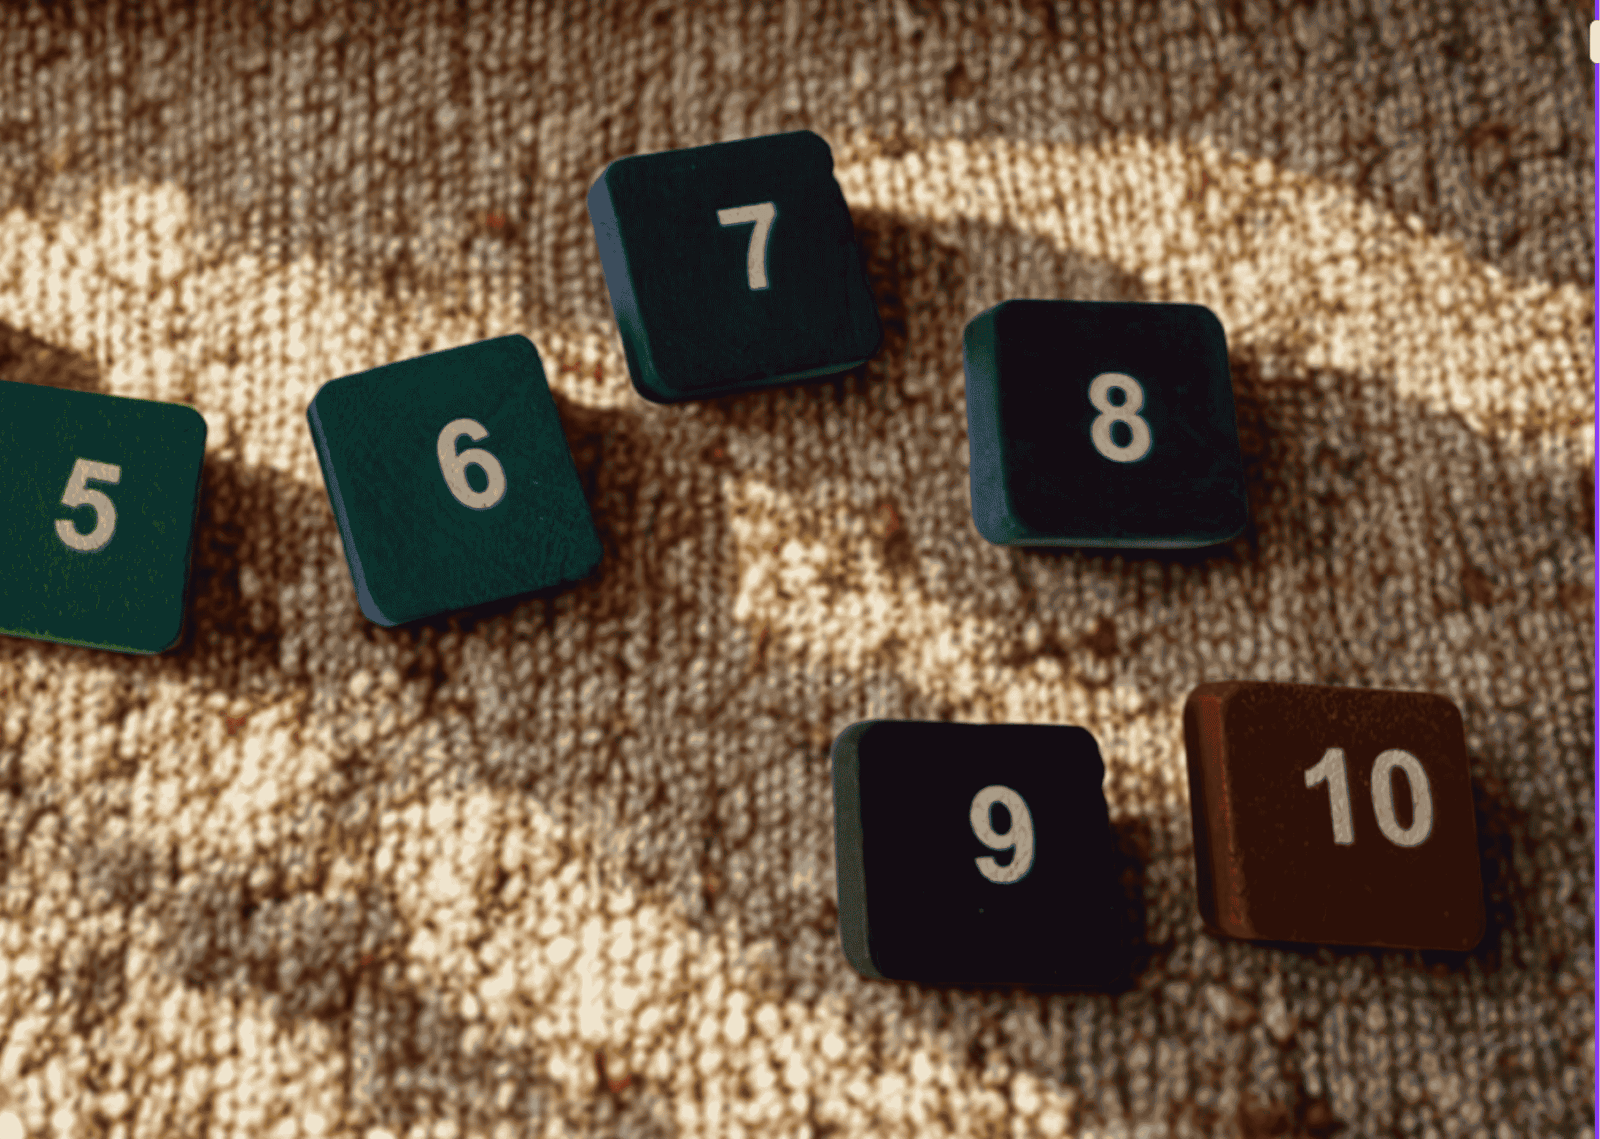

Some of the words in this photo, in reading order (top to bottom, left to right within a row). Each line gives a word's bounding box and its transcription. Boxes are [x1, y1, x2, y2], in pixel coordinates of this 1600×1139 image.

[717, 202, 776, 290] 7
[436, 418, 506, 509] 6
[1090, 373, 1151, 463] 8
[54, 458, 120, 551] 5
[970, 786, 1035, 883] 9
[1303, 748, 1433, 846] 10
